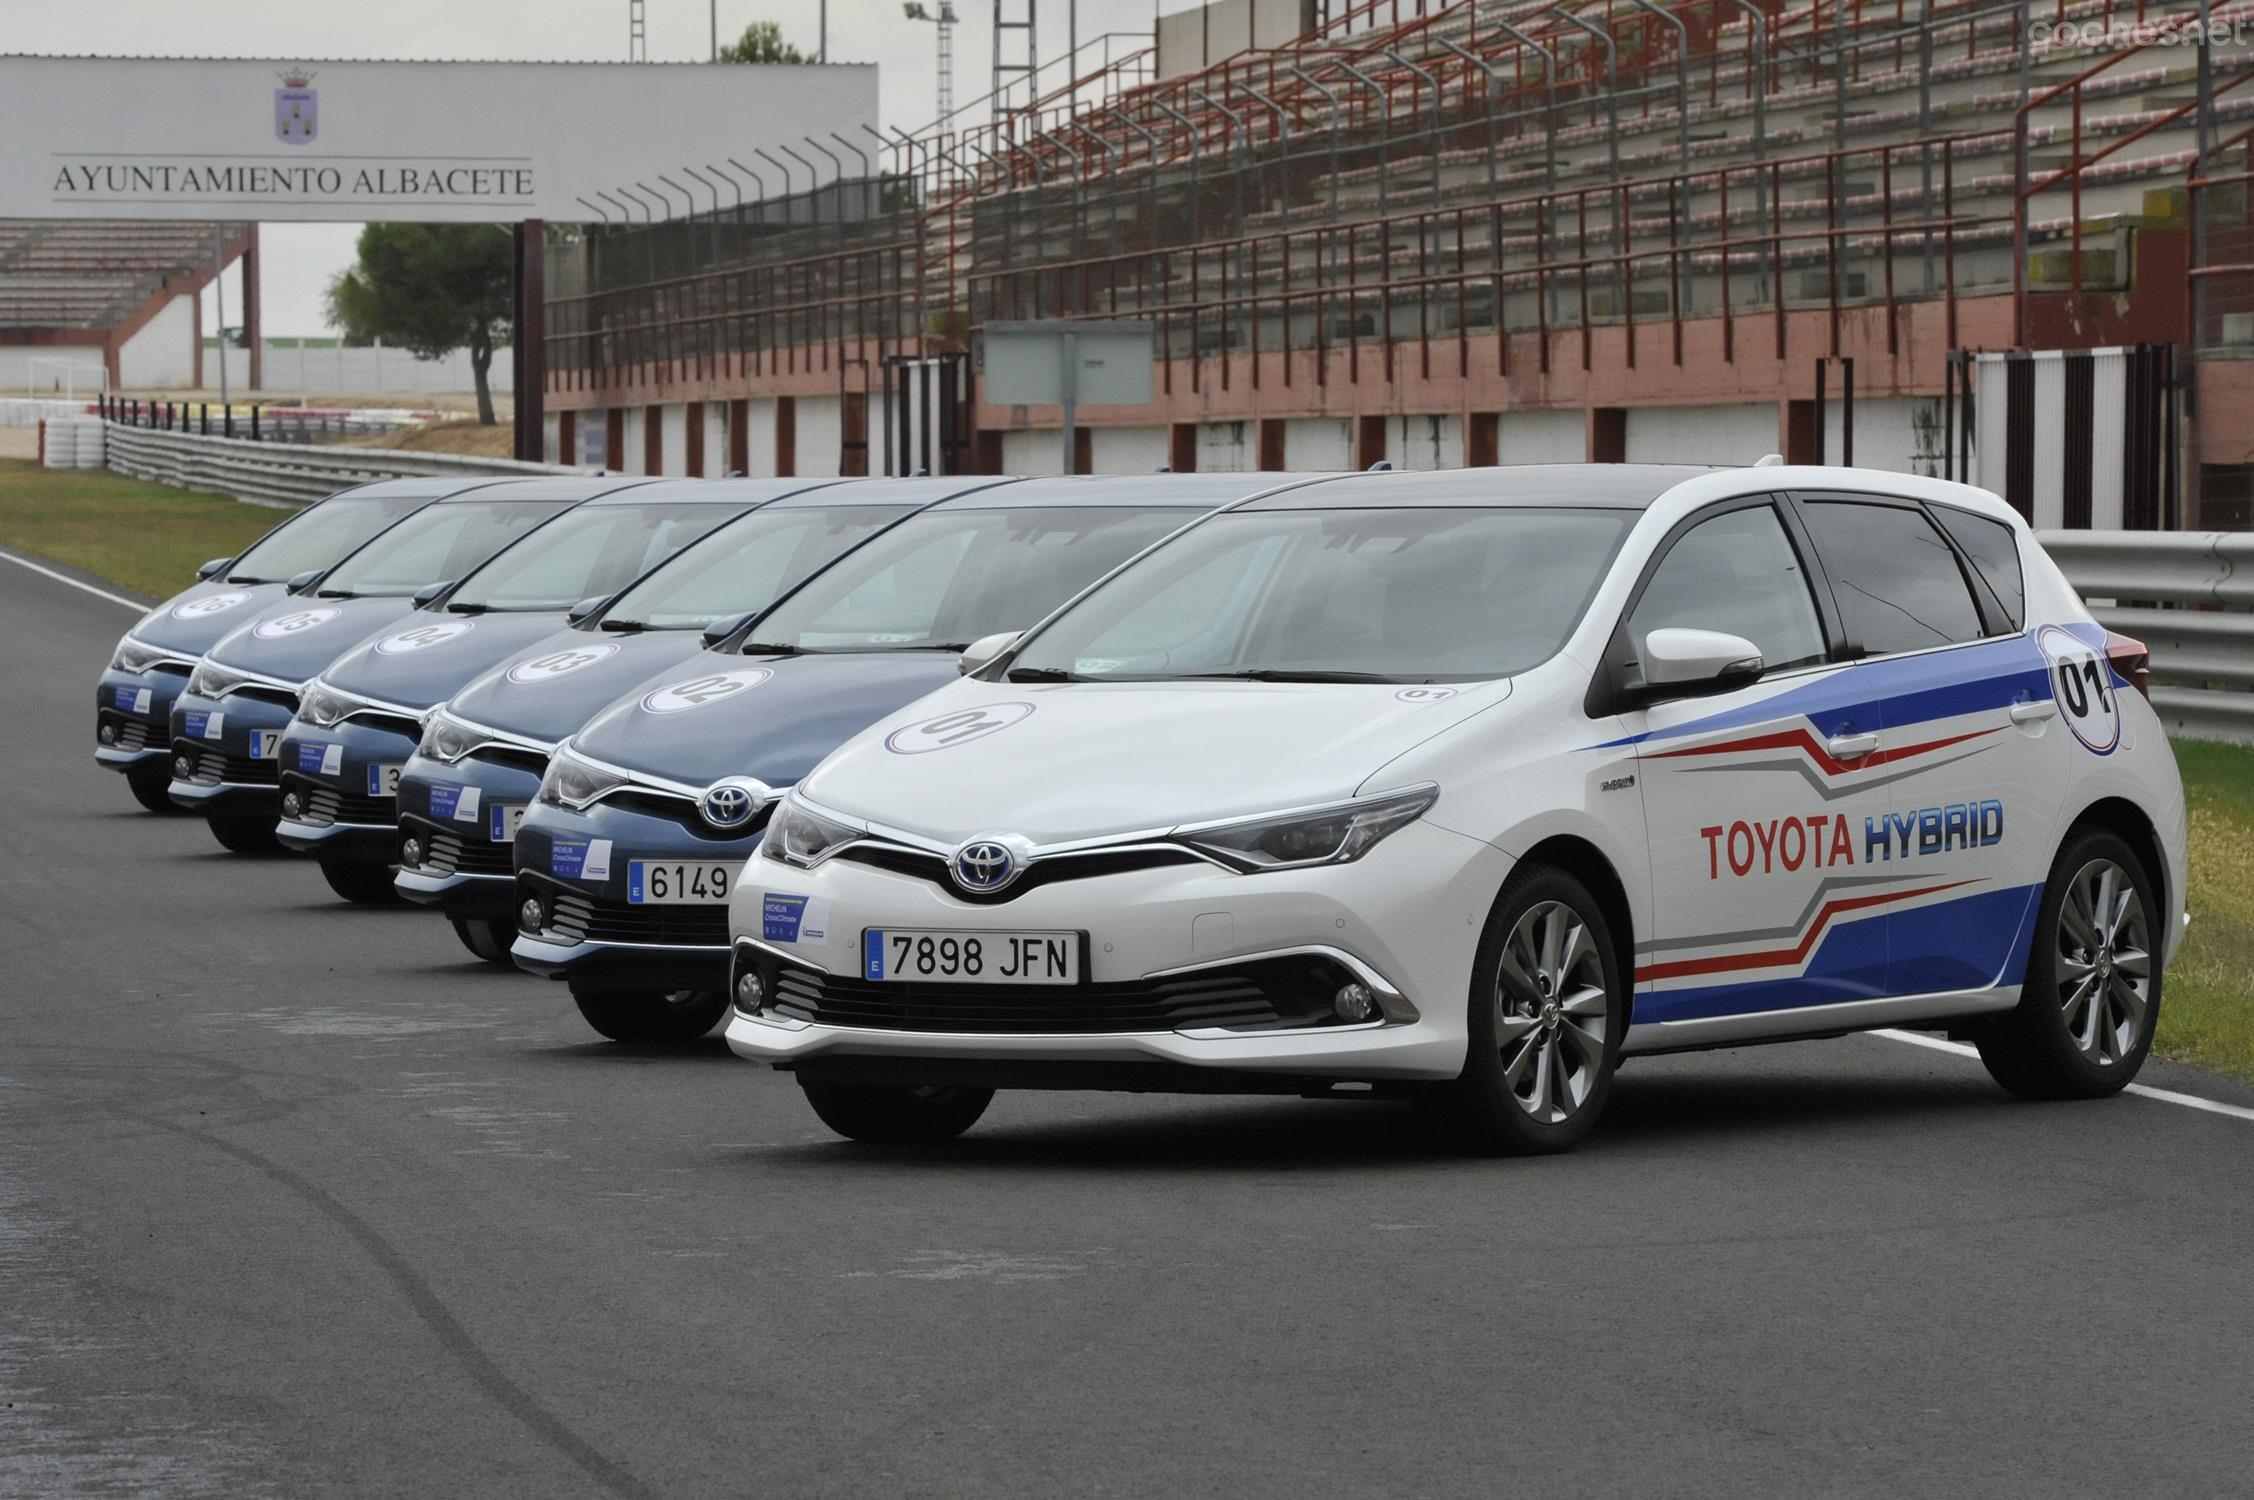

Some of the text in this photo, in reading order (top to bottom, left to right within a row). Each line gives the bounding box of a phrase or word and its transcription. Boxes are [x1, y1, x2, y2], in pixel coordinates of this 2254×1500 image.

[53, 165, 535, 196] AYUNTAMIENTO ALBACETE
[189, 597, 237, 612] 06
[275, 613, 321, 631] 05
[398, 627, 455, 647] 04
[530, 651, 597, 672] 03
[671, 676, 745, 704] 02
[1404, 690, 1450, 699] 01
[2058, 651, 2111, 718] 01
[920, 711, 1004, 745] 01
[1700, 799, 2003, 880] TOYOTA HYBRID
[651, 866, 728, 898] 6149
[871, 936, 1066, 977] E 7898 JFN
